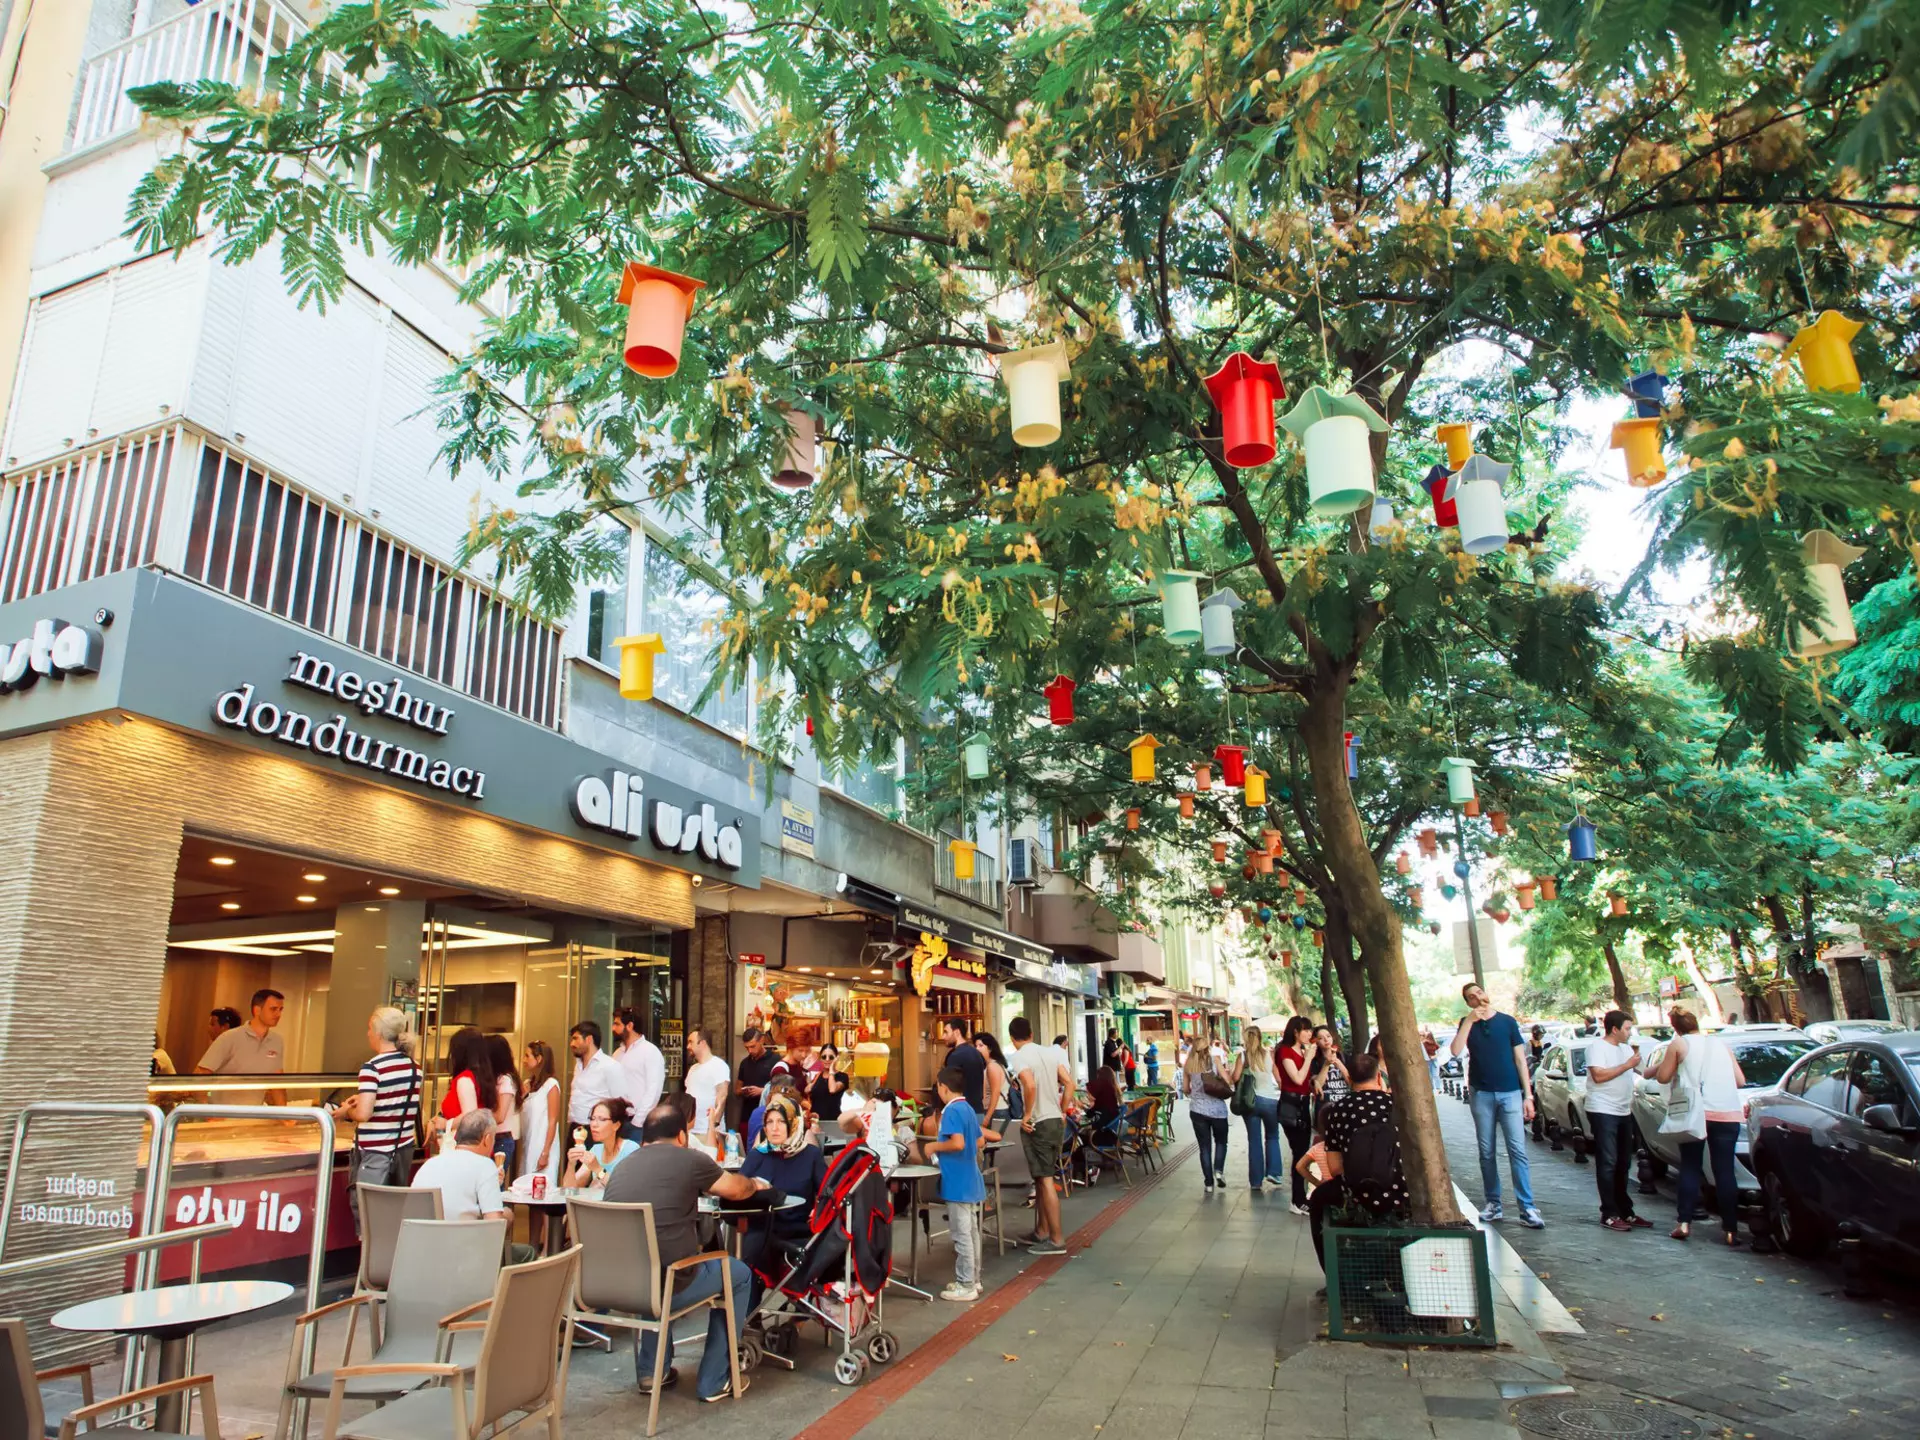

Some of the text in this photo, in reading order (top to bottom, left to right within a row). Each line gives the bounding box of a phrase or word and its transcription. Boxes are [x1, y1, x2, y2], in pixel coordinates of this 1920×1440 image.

[215, 682, 486, 800] dondurmacı
[288, 650, 455, 735] meşhur
[575, 769, 743, 869] ali usta
